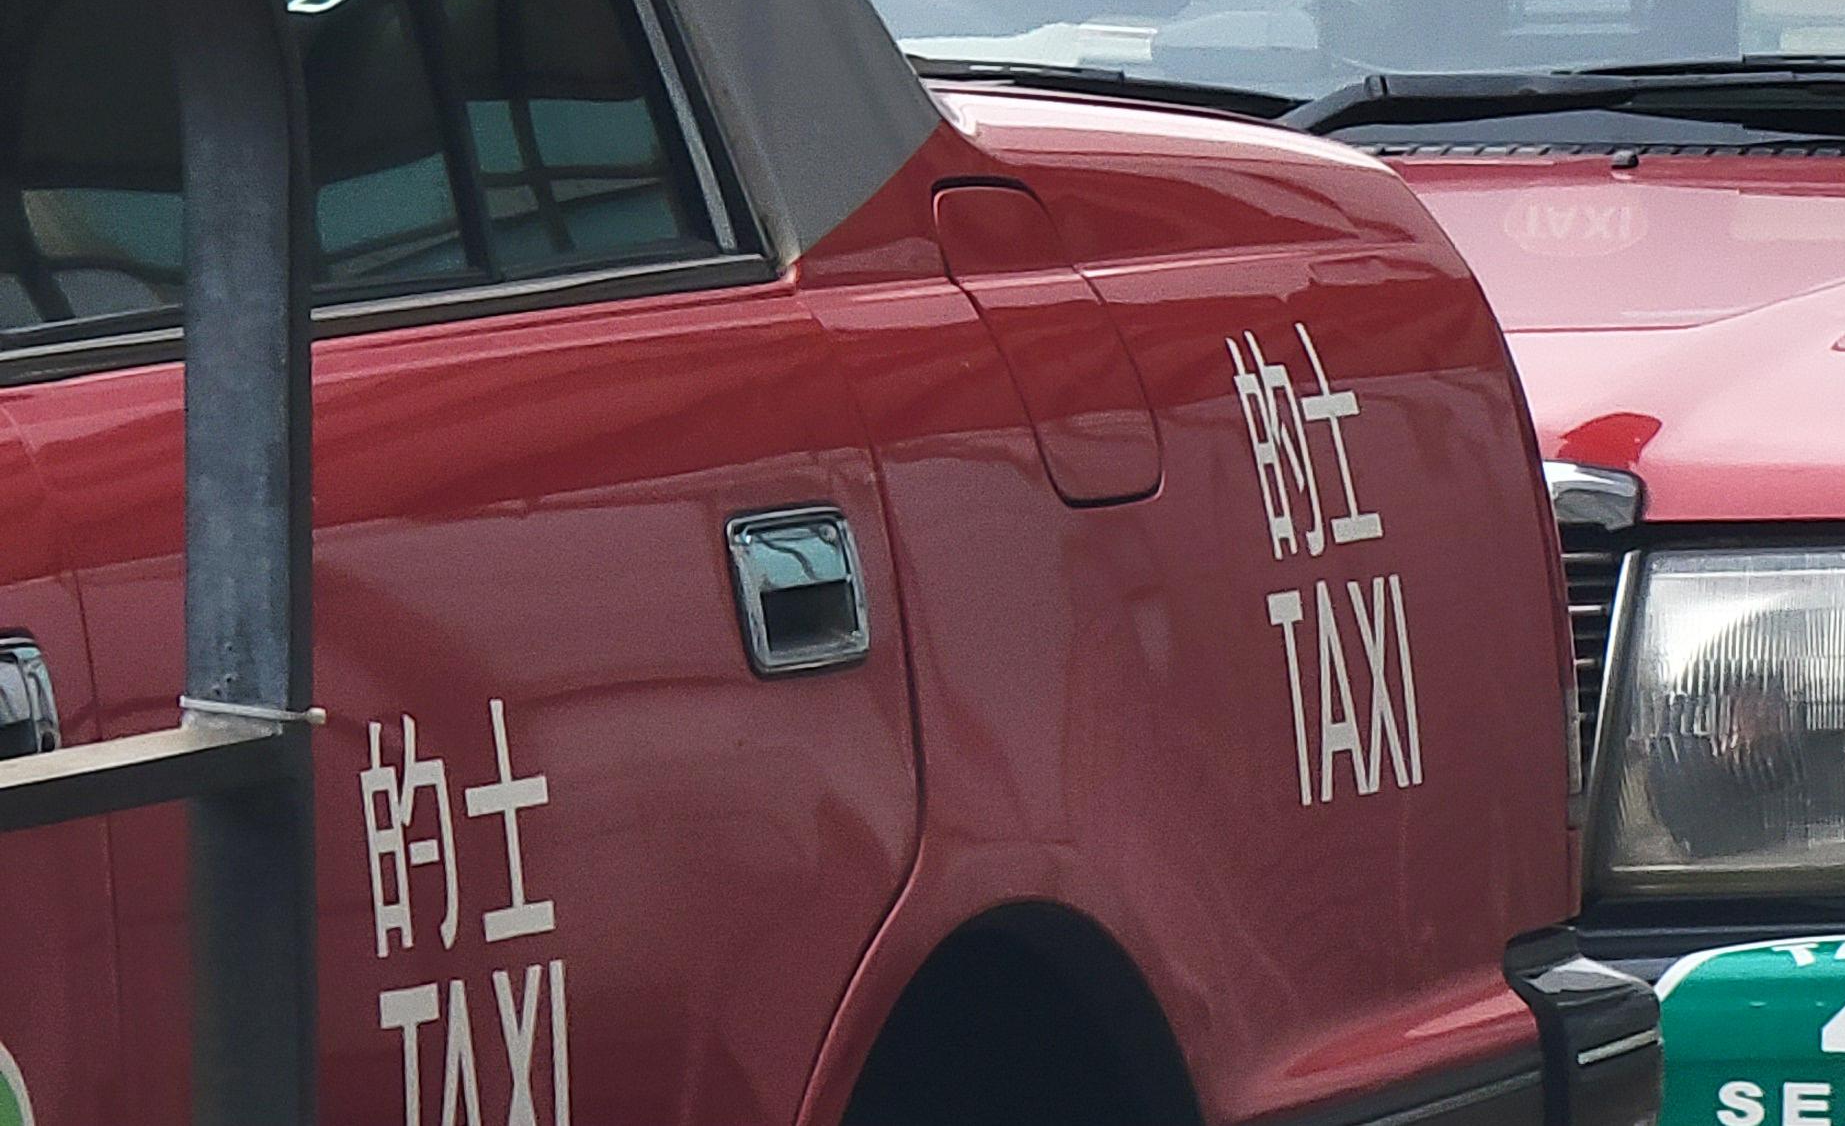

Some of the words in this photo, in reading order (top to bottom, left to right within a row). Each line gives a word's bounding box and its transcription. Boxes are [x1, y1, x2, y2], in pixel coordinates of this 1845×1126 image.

[1226, 322, 1384, 561] 的士
[1267, 574, 1423, 805] TAXI
[360, 699, 555, 958] 的士
[379, 959, 571, 1126] TAXI
